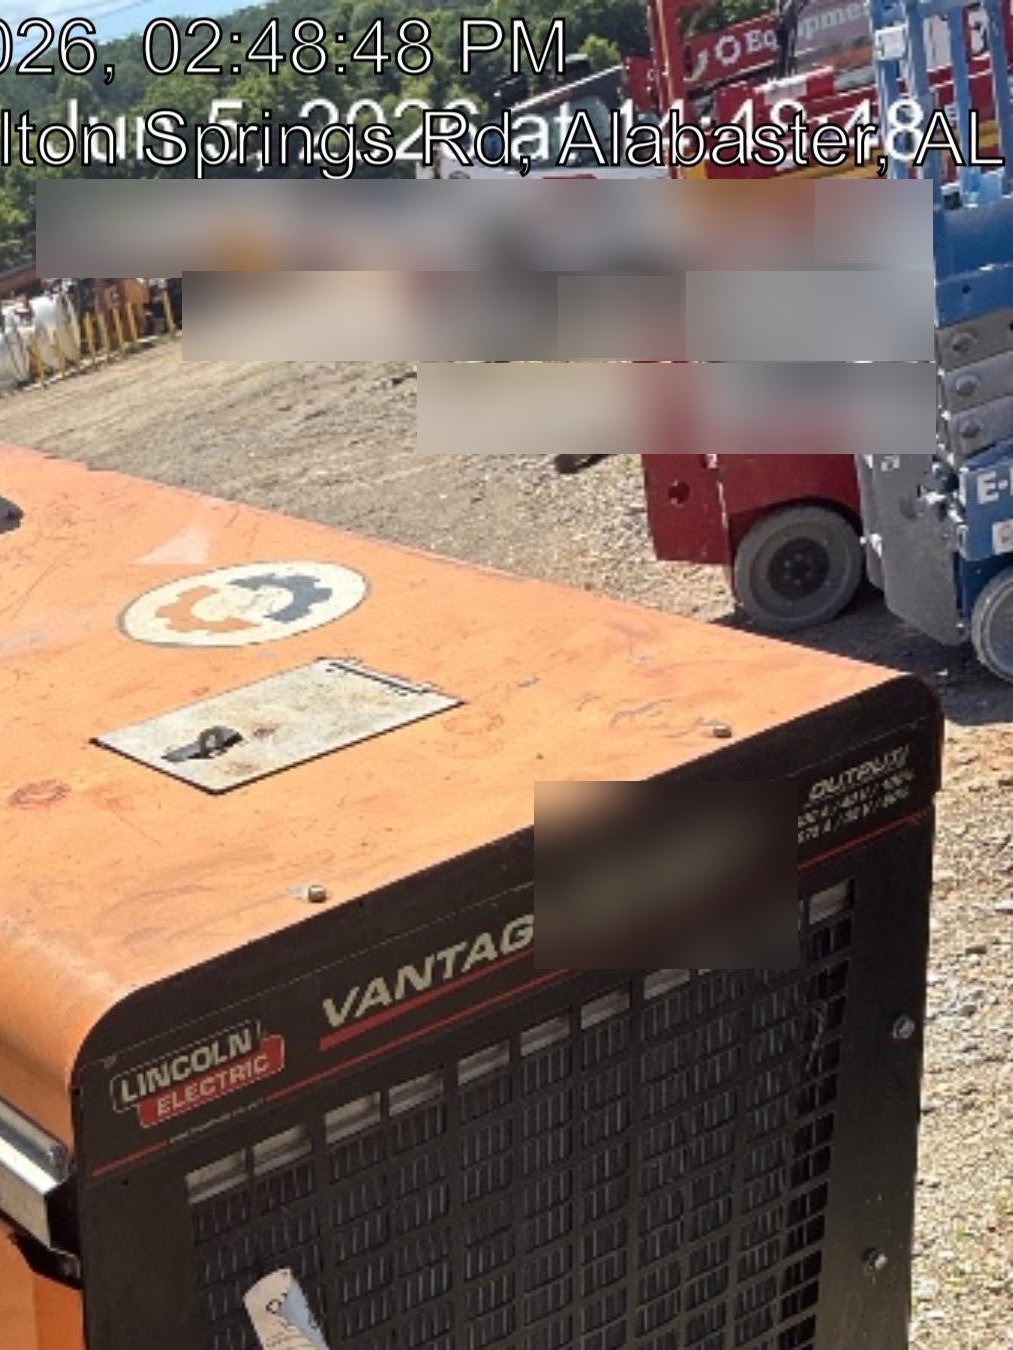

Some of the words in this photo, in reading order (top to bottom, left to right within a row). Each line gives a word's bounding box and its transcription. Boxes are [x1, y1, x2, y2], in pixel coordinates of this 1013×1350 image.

[322, 914, 535, 1027] VANTAG
[120, 1027, 253, 1104] LINCOLN
[156, 1052, 271, 1117] ELECTRIC
